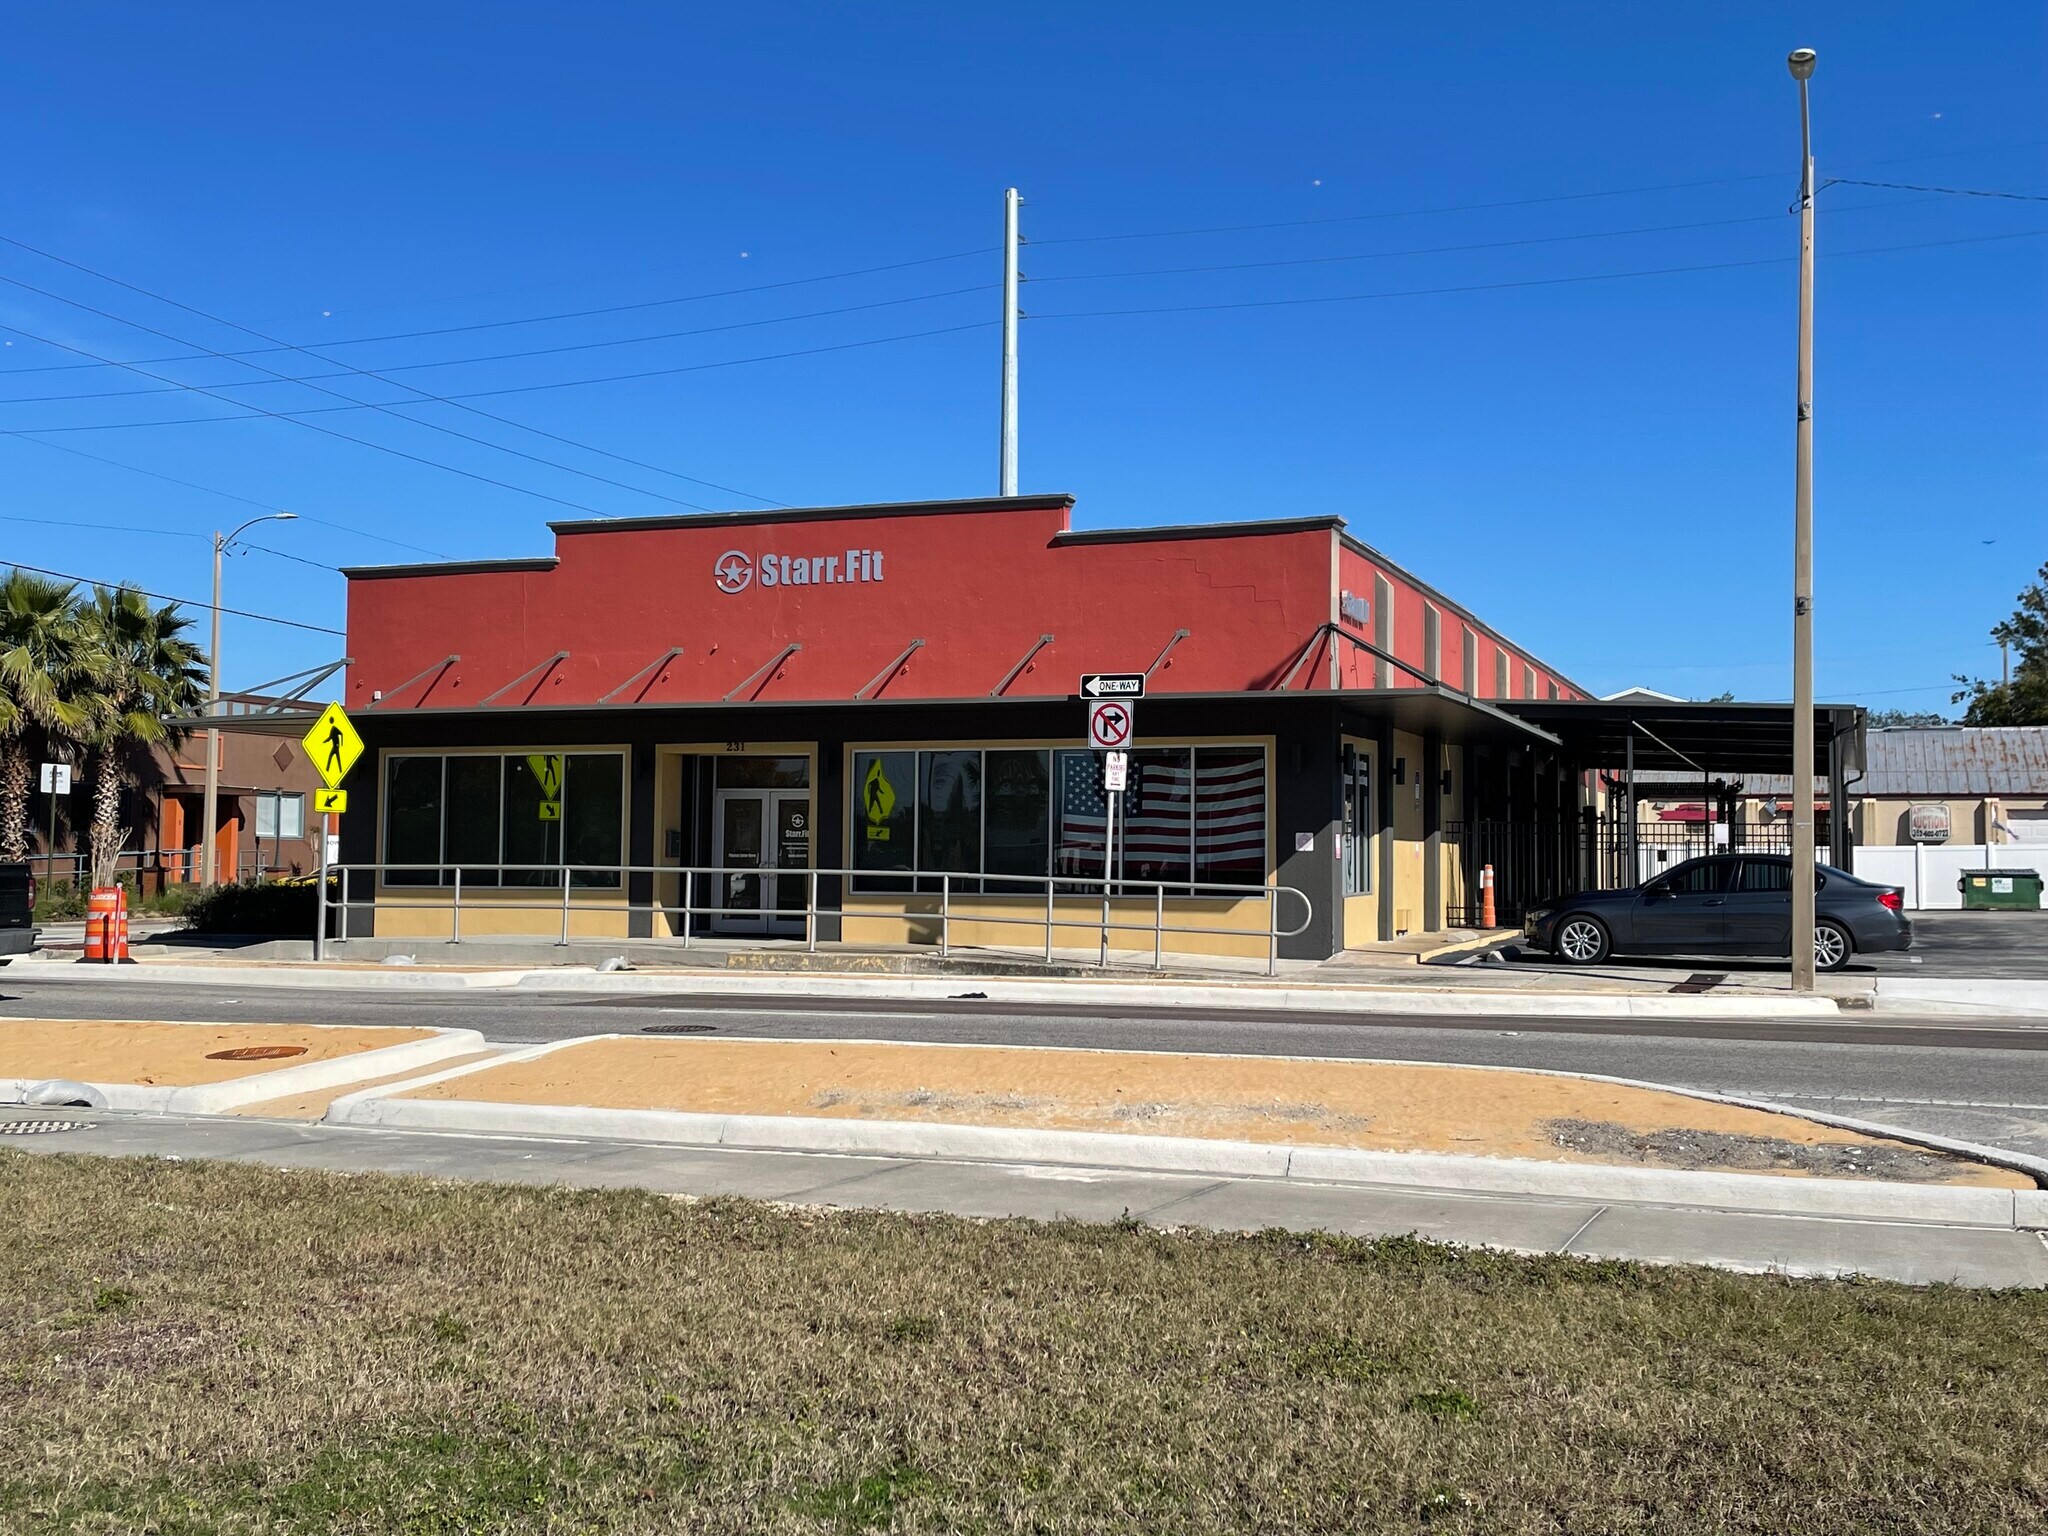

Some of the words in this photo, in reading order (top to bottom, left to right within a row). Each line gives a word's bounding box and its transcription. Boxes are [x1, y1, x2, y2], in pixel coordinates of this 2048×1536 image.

[761, 550, 884, 587] Starr.Fit
[1099, 682, 1117, 691] ONE
[1120, 681, 1137, 691] WAY
[726, 742, 745, 752] 231
